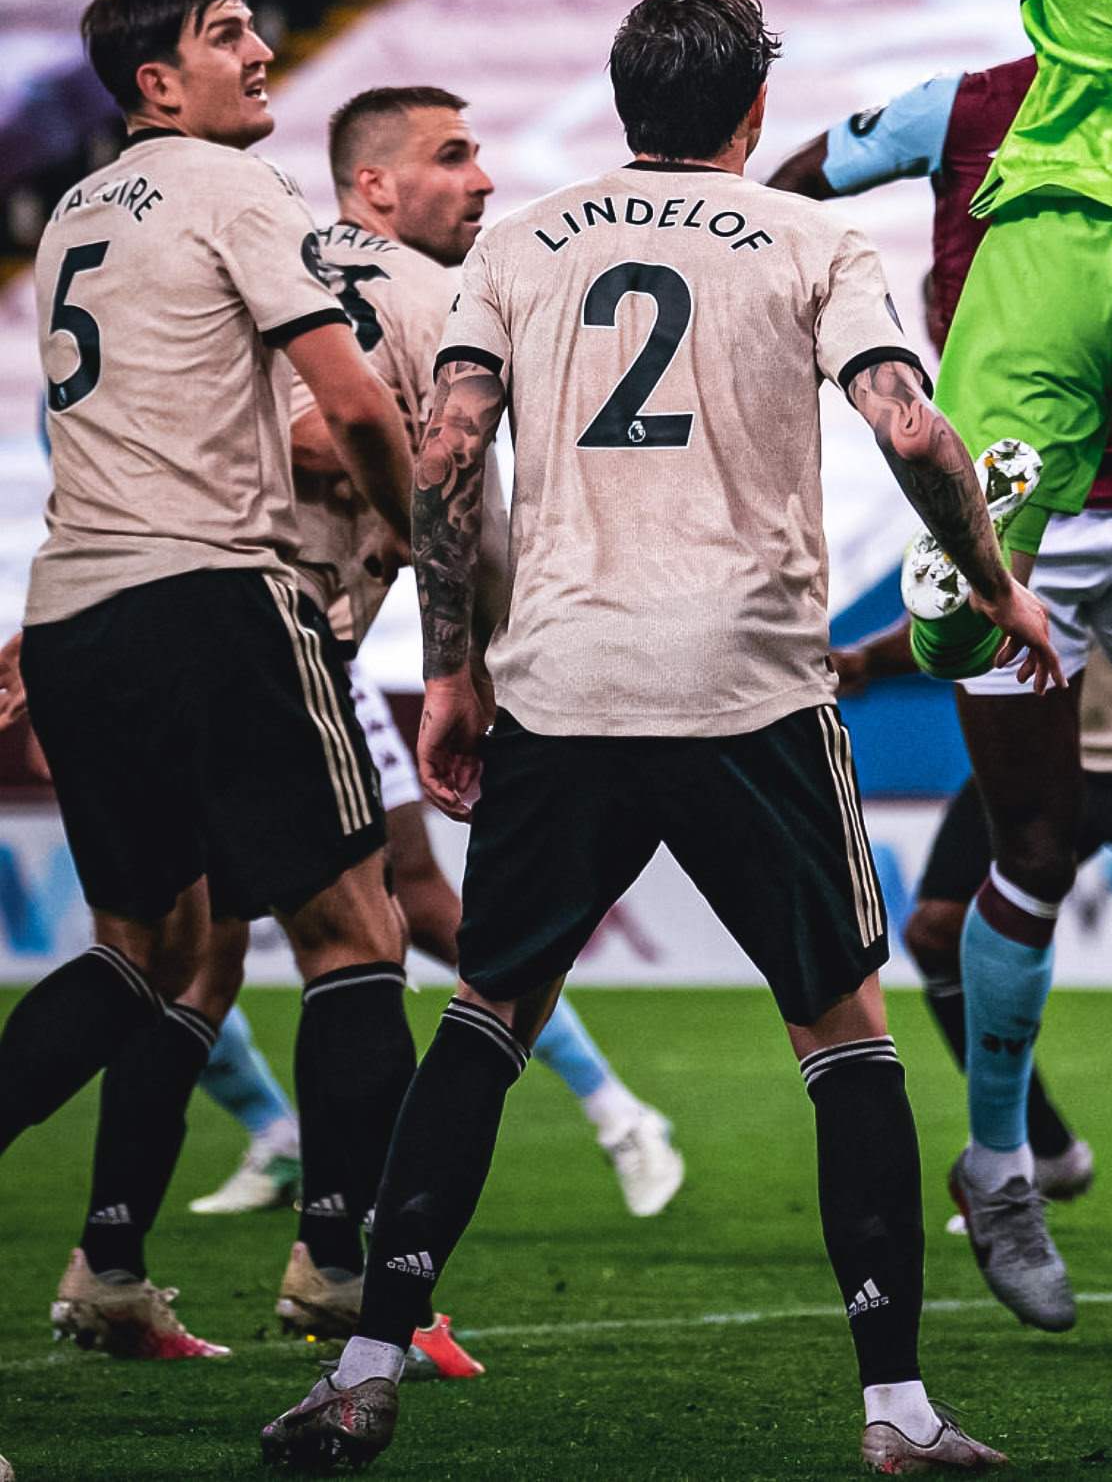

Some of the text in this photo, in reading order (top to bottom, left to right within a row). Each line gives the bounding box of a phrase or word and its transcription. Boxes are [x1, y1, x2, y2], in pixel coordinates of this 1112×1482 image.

[534, 195, 774, 254] LINDELOF
[47, 239, 111, 415] 5
[575, 260, 694, 450] 2
[386, 1261, 437, 1280] adidas
[848, 1296, 890, 1319] didas
